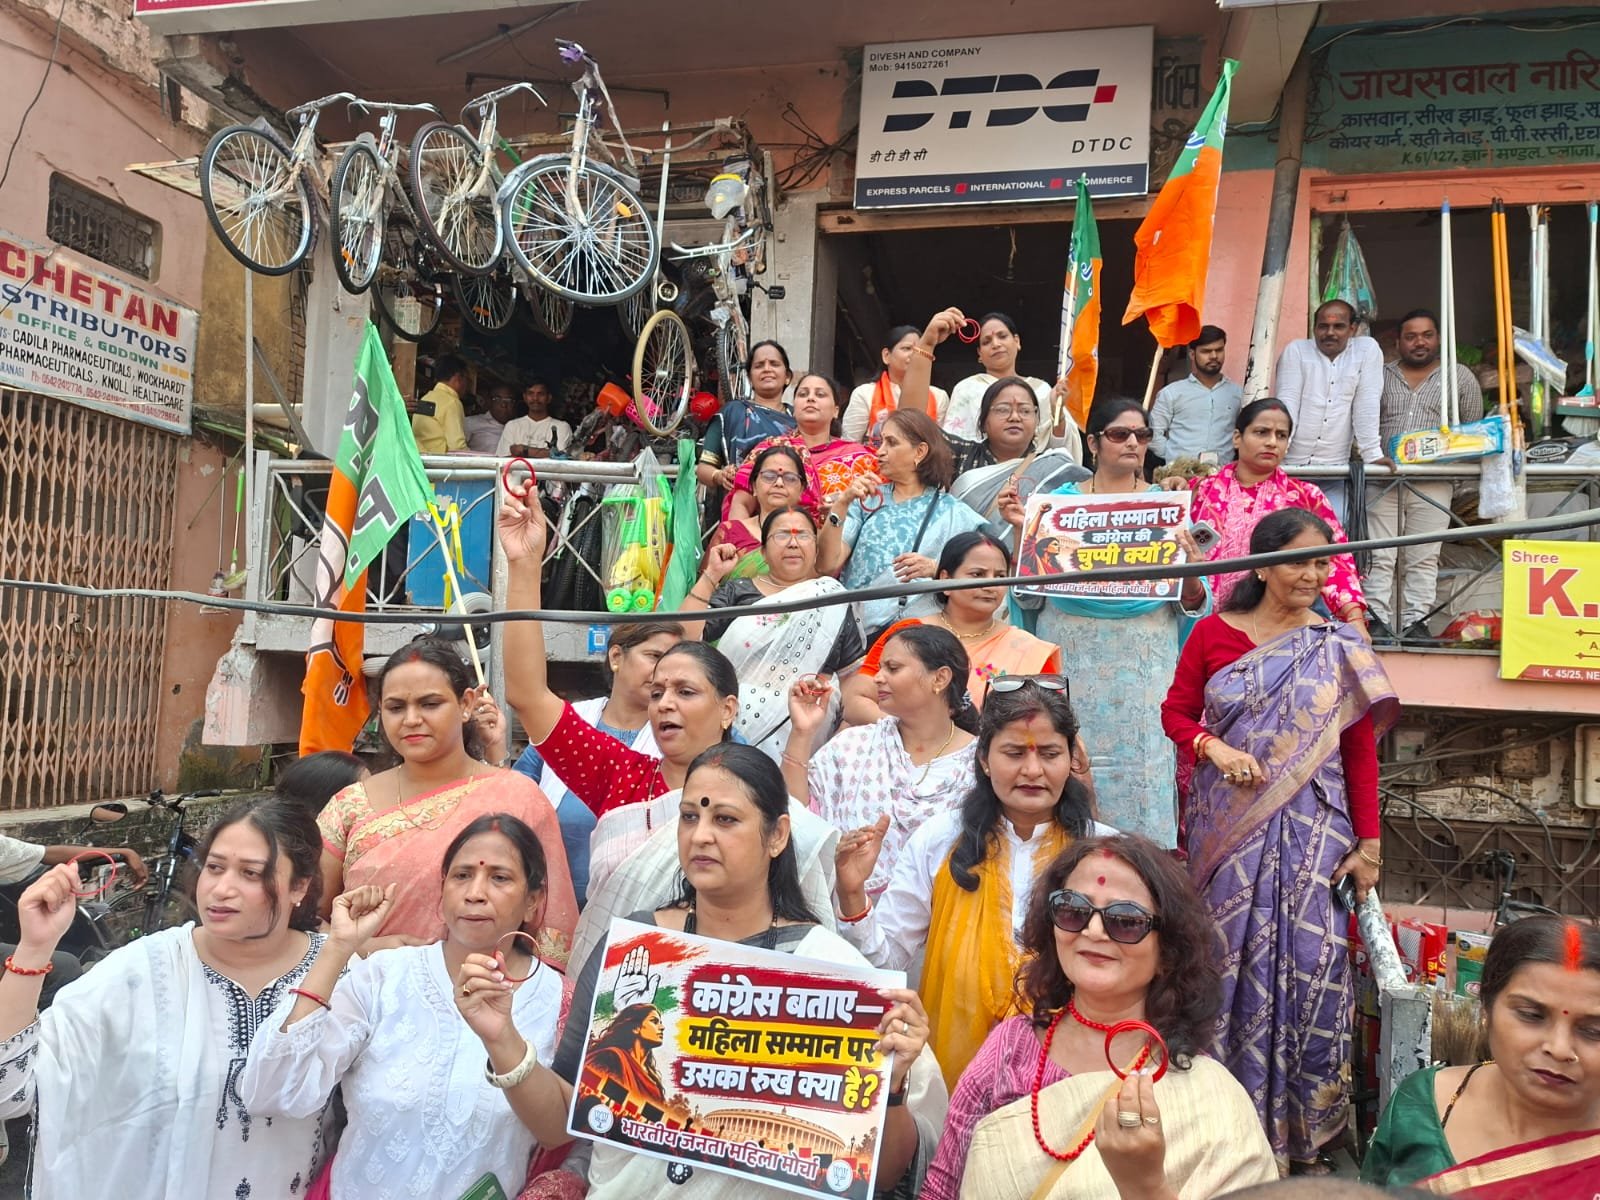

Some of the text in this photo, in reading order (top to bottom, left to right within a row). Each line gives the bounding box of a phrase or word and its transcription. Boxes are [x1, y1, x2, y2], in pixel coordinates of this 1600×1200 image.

[869, 47, 982, 62] DIVESH AND COMPANY
[869, 60, 949, 73] Mob: 9415027261
[883, 68, 1100, 132] DTDC
[1339, 62, 1520, 101] जायसवाल
[1071, 136, 1133, 154] DTDC
[866, 176, 1133, 197] EXPRESS PARCELS INTERNATIONAL E-OMMERCE
[0, 240, 178, 338] CHETAN
[18, 312, 159, 370] OFFICE & GODOWN
[13, 329, 48, 351] CADILA
[137, 369, 186, 395] WOCKHARDT
[102, 373, 129, 395] KNOLL
[132, 383, 184, 412] HEALTHCARE
[1059, 505, 1180, 529] महिला सम्मान पर
[1092, 528, 1152, 544] कांग्रेस की
[1077, 542, 1120, 571] चुप्पी
[1511, 550, 1559, 564] Shree
[1528, 567, 1599, 618] K.
[692, 973, 783, 1018] कांग्रेस
[688, 1017, 880, 1063] महिला सम्मान पर
[680, 1060, 750, 1091] उसका
[751, 1066, 796, 1096] रुख
[797, 1070, 843, 1102] क्या
[621, 1117, 820, 1182] भारतीय जनता महिला मोर्चा
